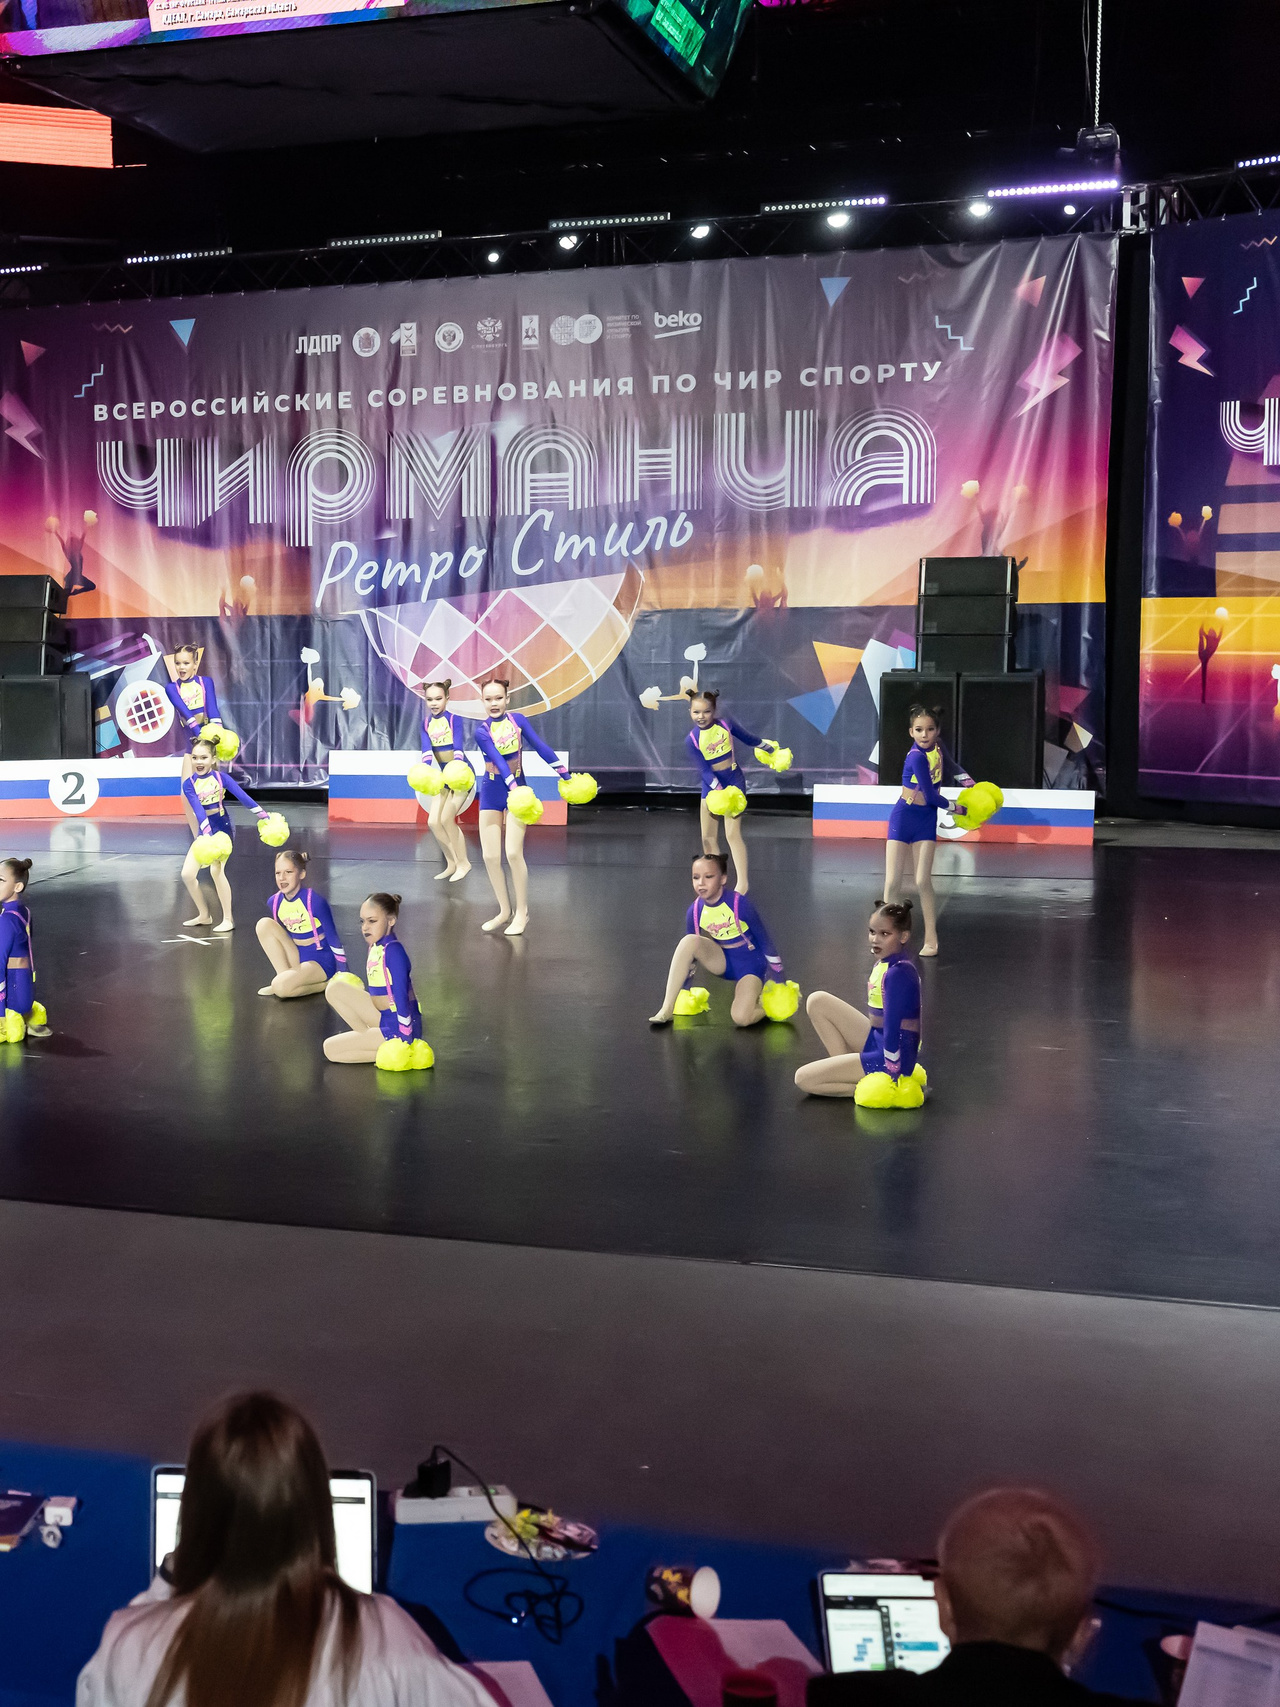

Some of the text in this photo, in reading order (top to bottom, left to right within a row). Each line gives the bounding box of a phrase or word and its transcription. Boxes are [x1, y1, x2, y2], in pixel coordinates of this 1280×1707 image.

[654, 310, 702, 328] beko
[295, 334, 342, 356] ЛДПР
[93, 360, 942, 422] ВСЕРОССИЙСКИЕ СОРЕВНОВАНИЯ ПО ЧИР СПОРТУ
[316, 508, 694, 607] Ретро Стиль
[62, 772, 85, 804] 2
